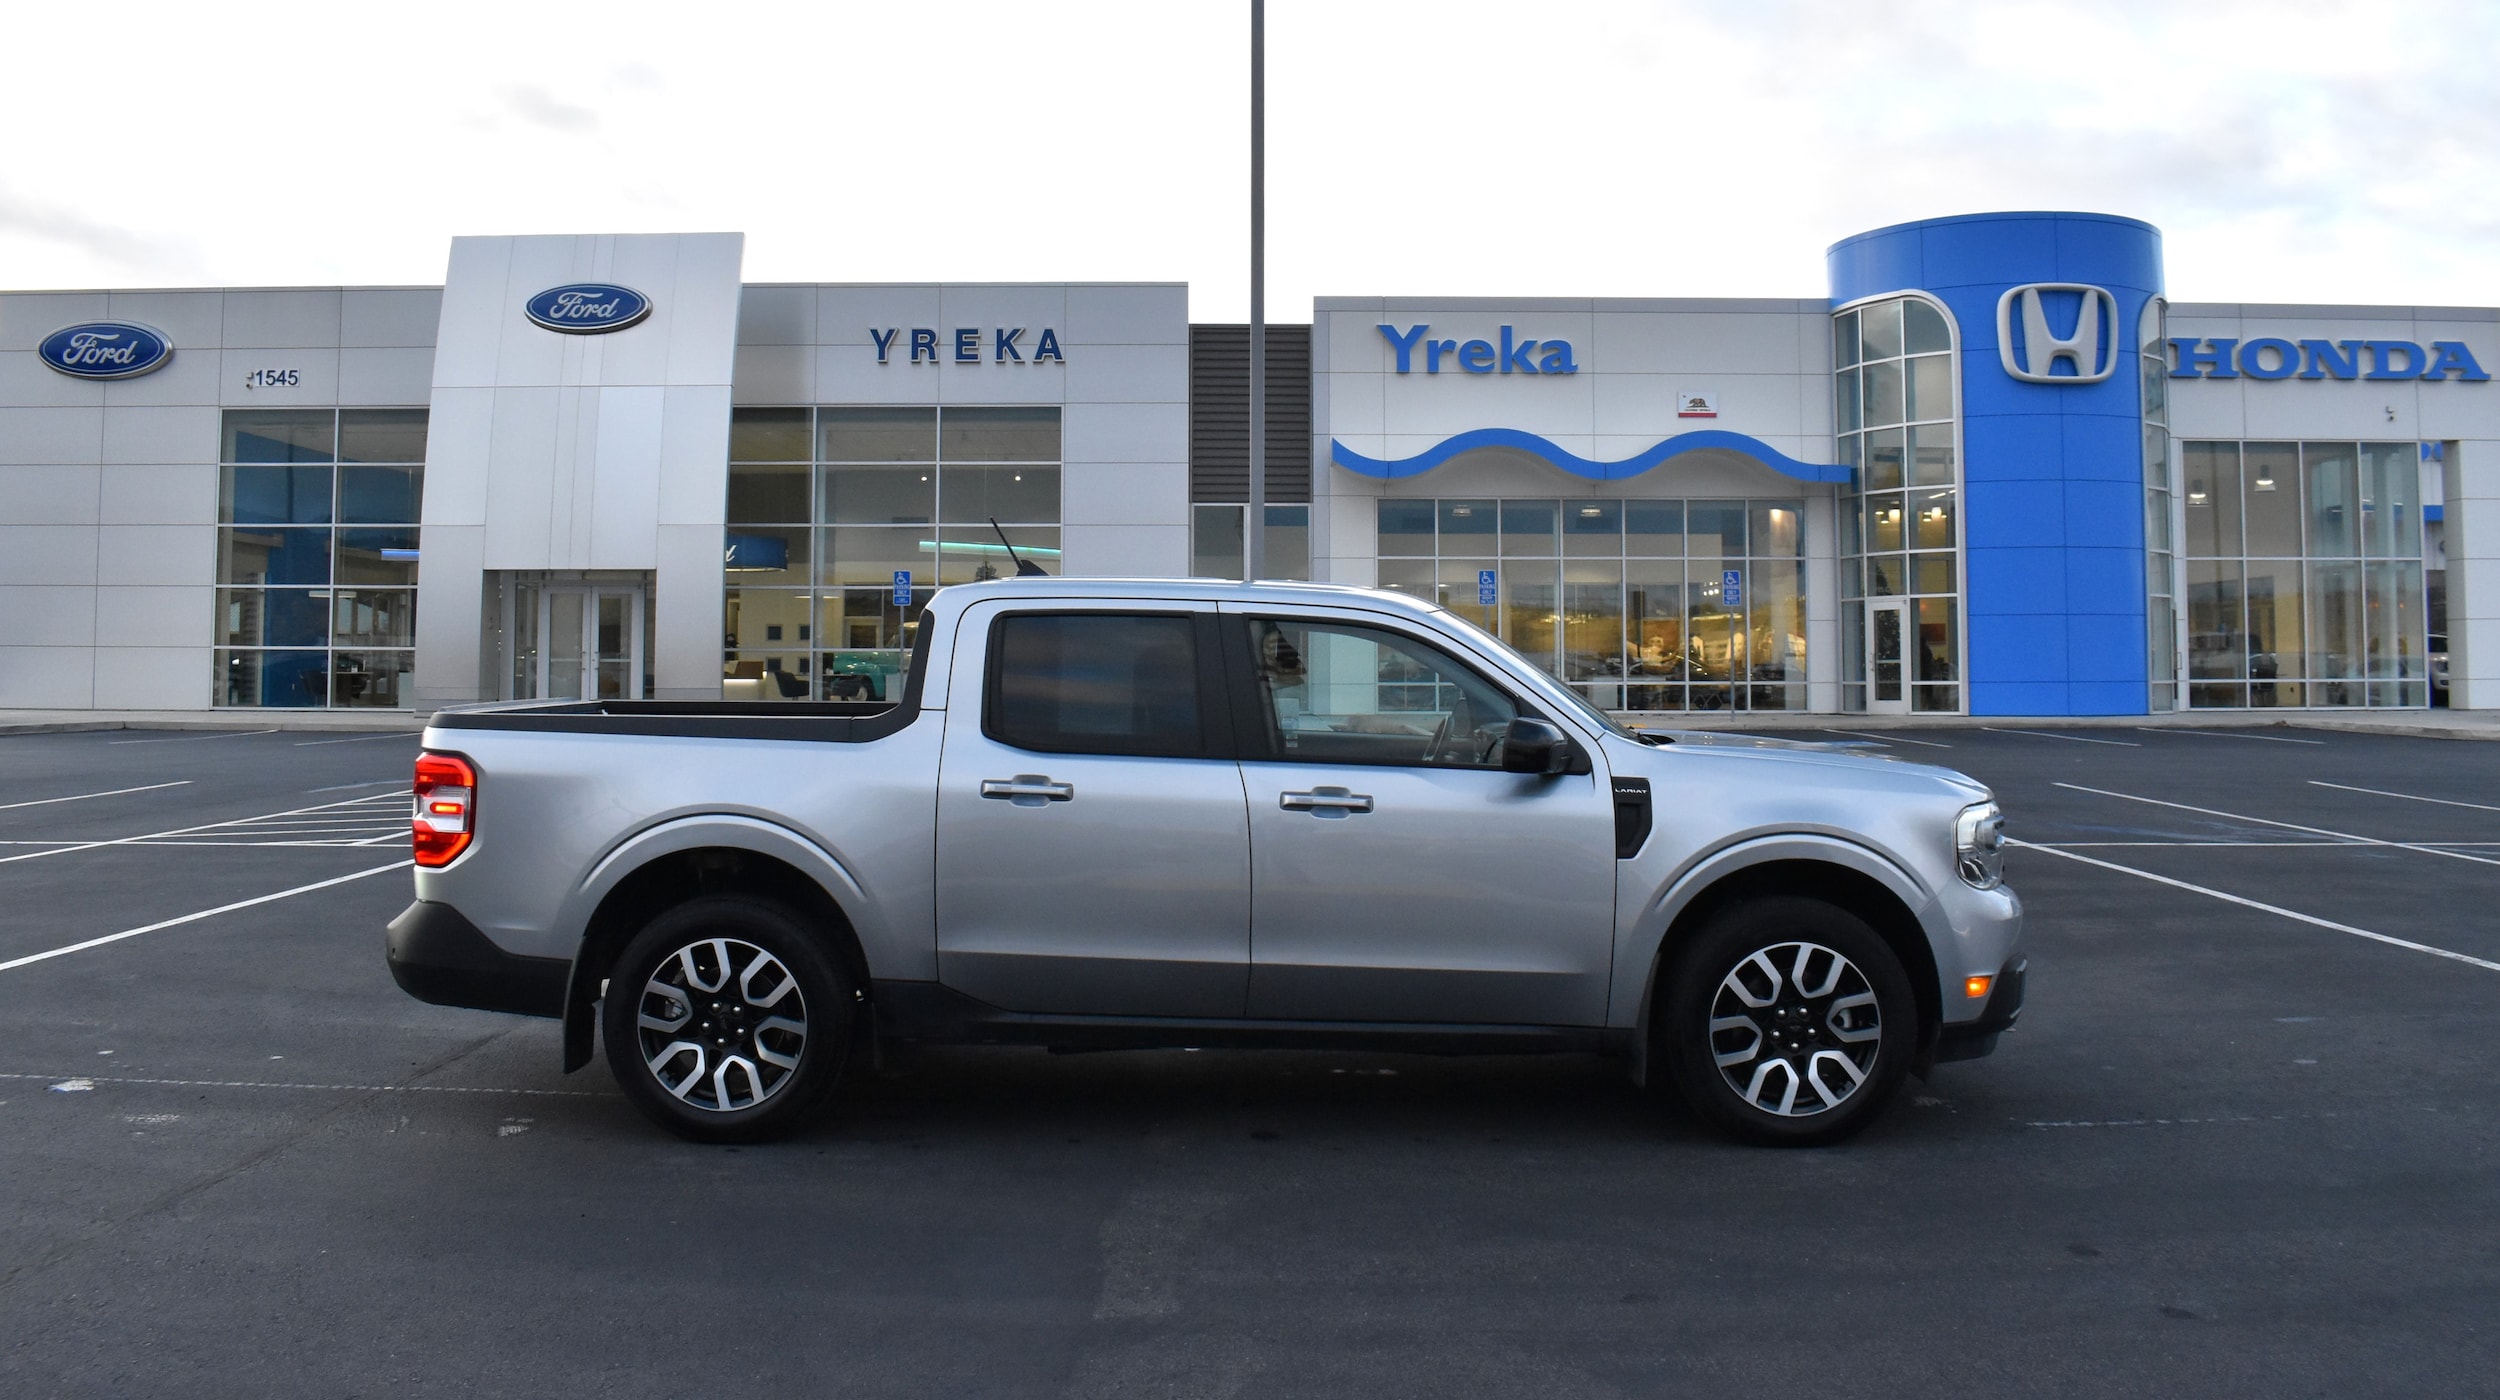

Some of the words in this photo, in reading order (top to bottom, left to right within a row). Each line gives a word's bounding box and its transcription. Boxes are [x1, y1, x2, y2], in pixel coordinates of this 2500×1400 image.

[548, 291, 620, 319] Ford
[62, 332, 138, 365] Ford
[869, 327, 1066, 364] YREKA
[1375, 324, 1579, 374] Yreka
[2167, 337, 2491, 381] HONDA
[255, 369, 299, 386] 1545
